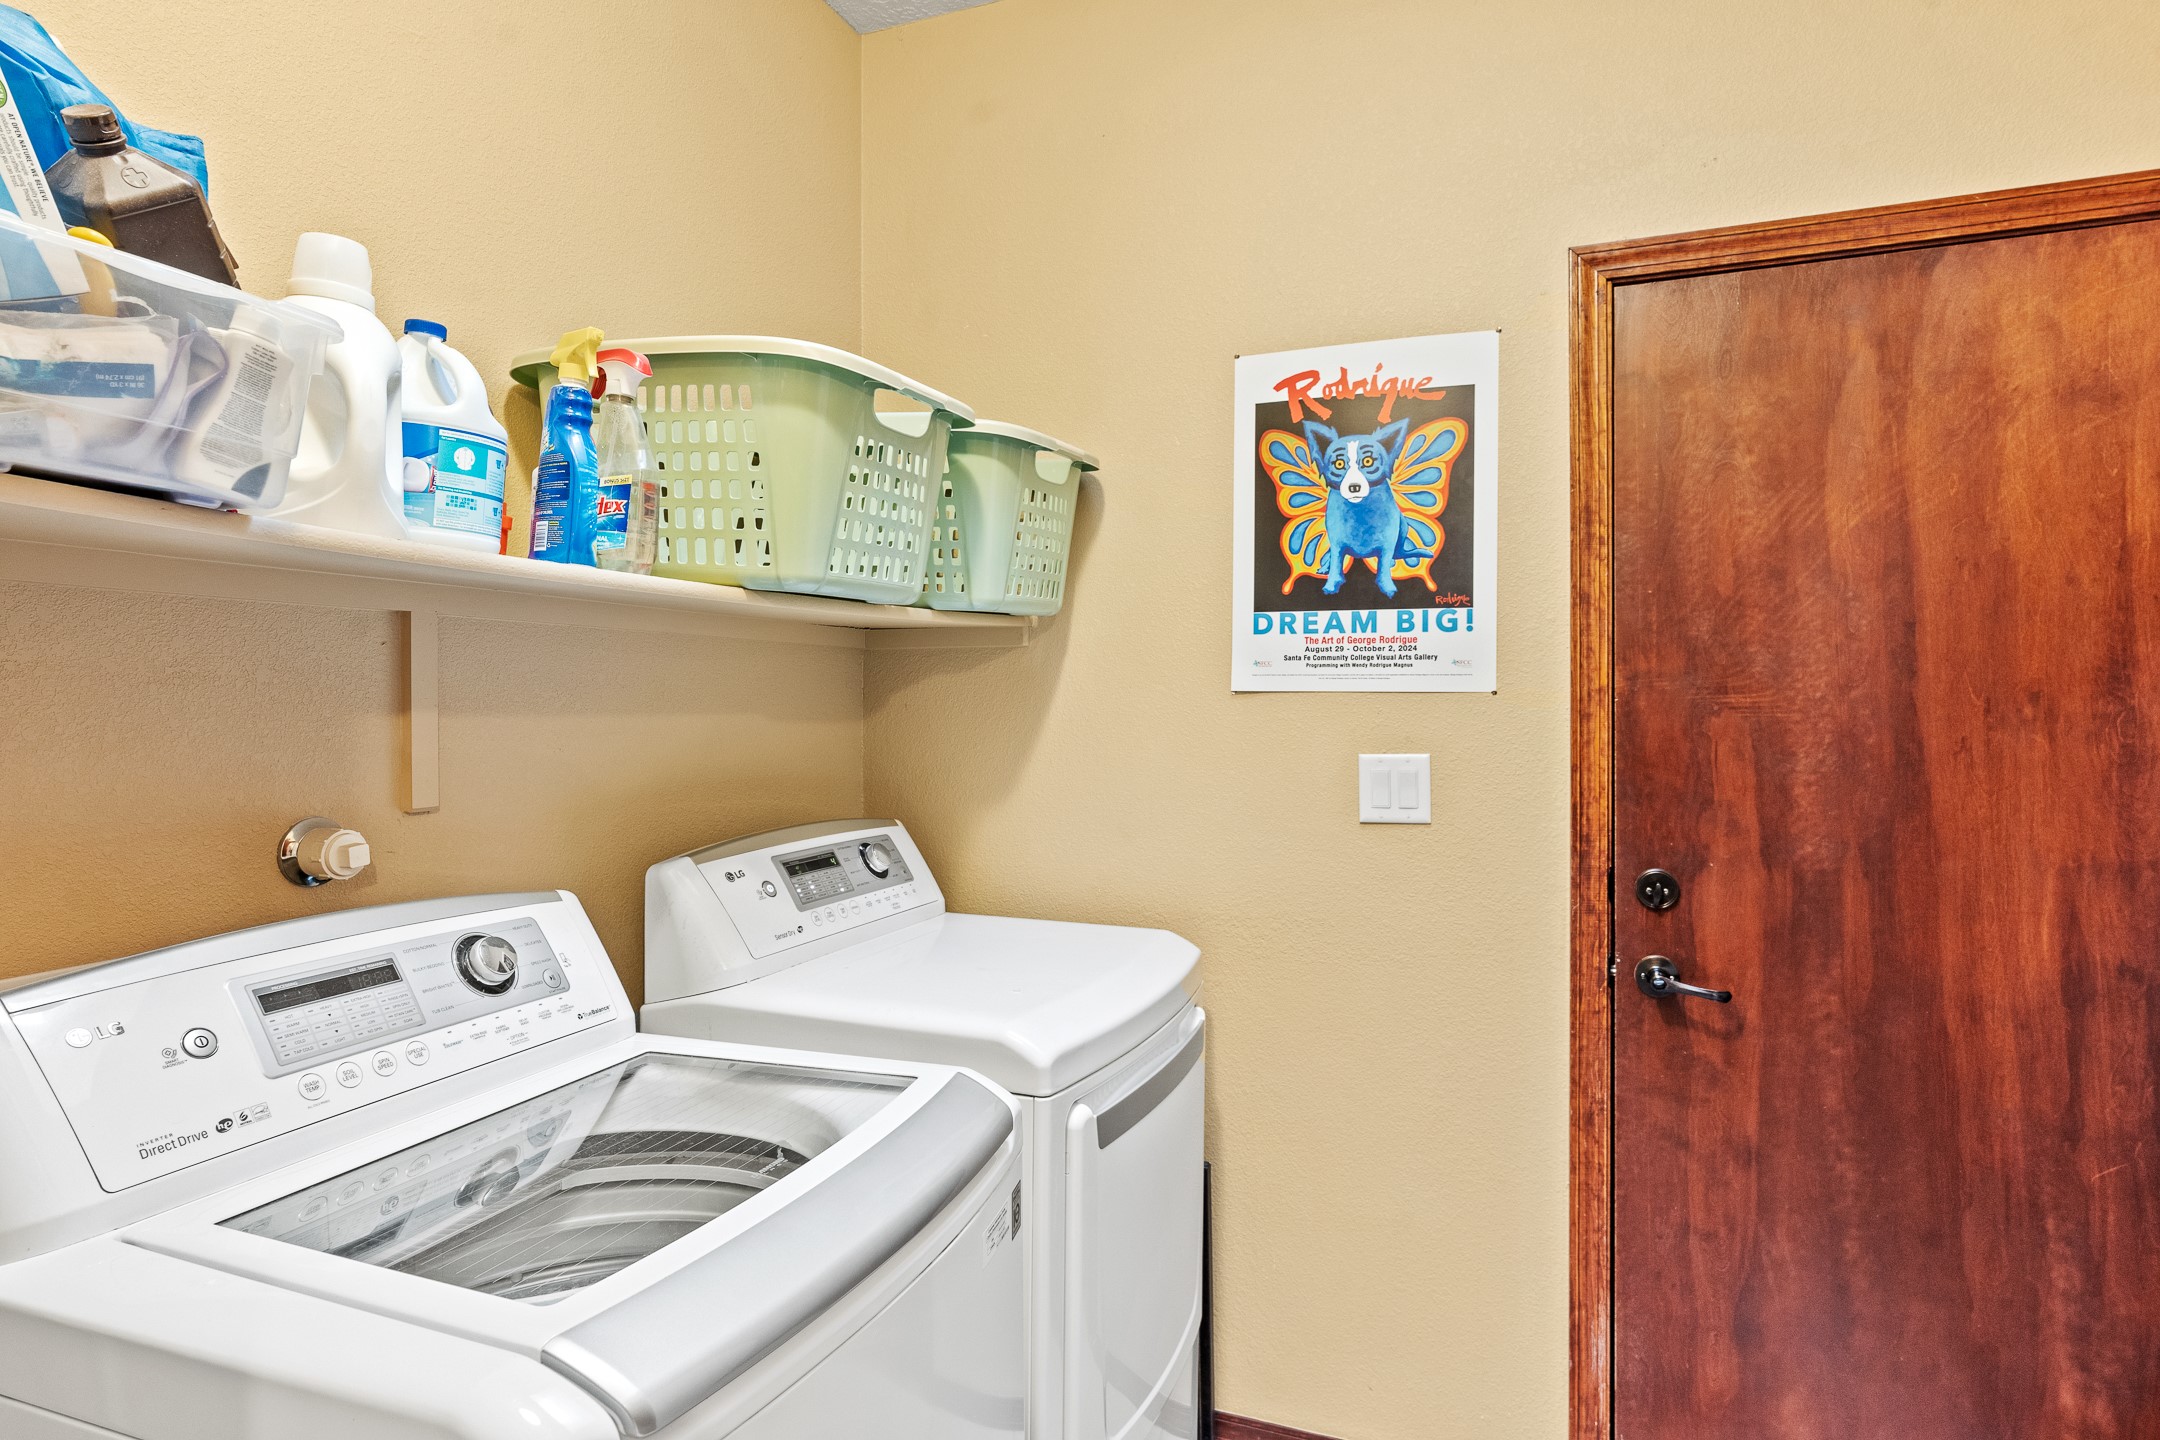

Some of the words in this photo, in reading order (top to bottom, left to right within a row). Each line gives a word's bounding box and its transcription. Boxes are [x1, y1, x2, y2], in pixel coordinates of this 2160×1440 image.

[11, 122, 22, 138] OPEN
[34, 179, 49, 203] BELIEVE
[1273, 362, 1446, 424] Rodrigue
[597, 497, 624, 515] dex
[1253, 610, 1377, 635] DREAM
[1397, 608, 1474, 632] BIG!
[1304, 636, 1320, 645] The
[1321, 636, 1334, 645] Art
[1336, 635, 1344, 645] of
[1347, 636, 1376, 646] George
[1379, 635, 1418, 646] Rodrigue
[1312, 654, 1348, 662] Community
[1350, 654, 1374, 662] College
[1414, 654, 1438, 662] Gallery
[734, 870, 746, 878] LG
[775, 931, 788, 940] Sensor
[94, 1021, 125, 1040] LG
[408, 1047, 426, 1055] SPECIAL
[378, 1062, 394, 1070] SPEED
[343, 1073, 359, 1082] LEVEL
[137, 1133, 173, 1148] INVERTER
[139, 1139, 177, 1159] Direct
[177, 1129, 209, 1147] Drive
